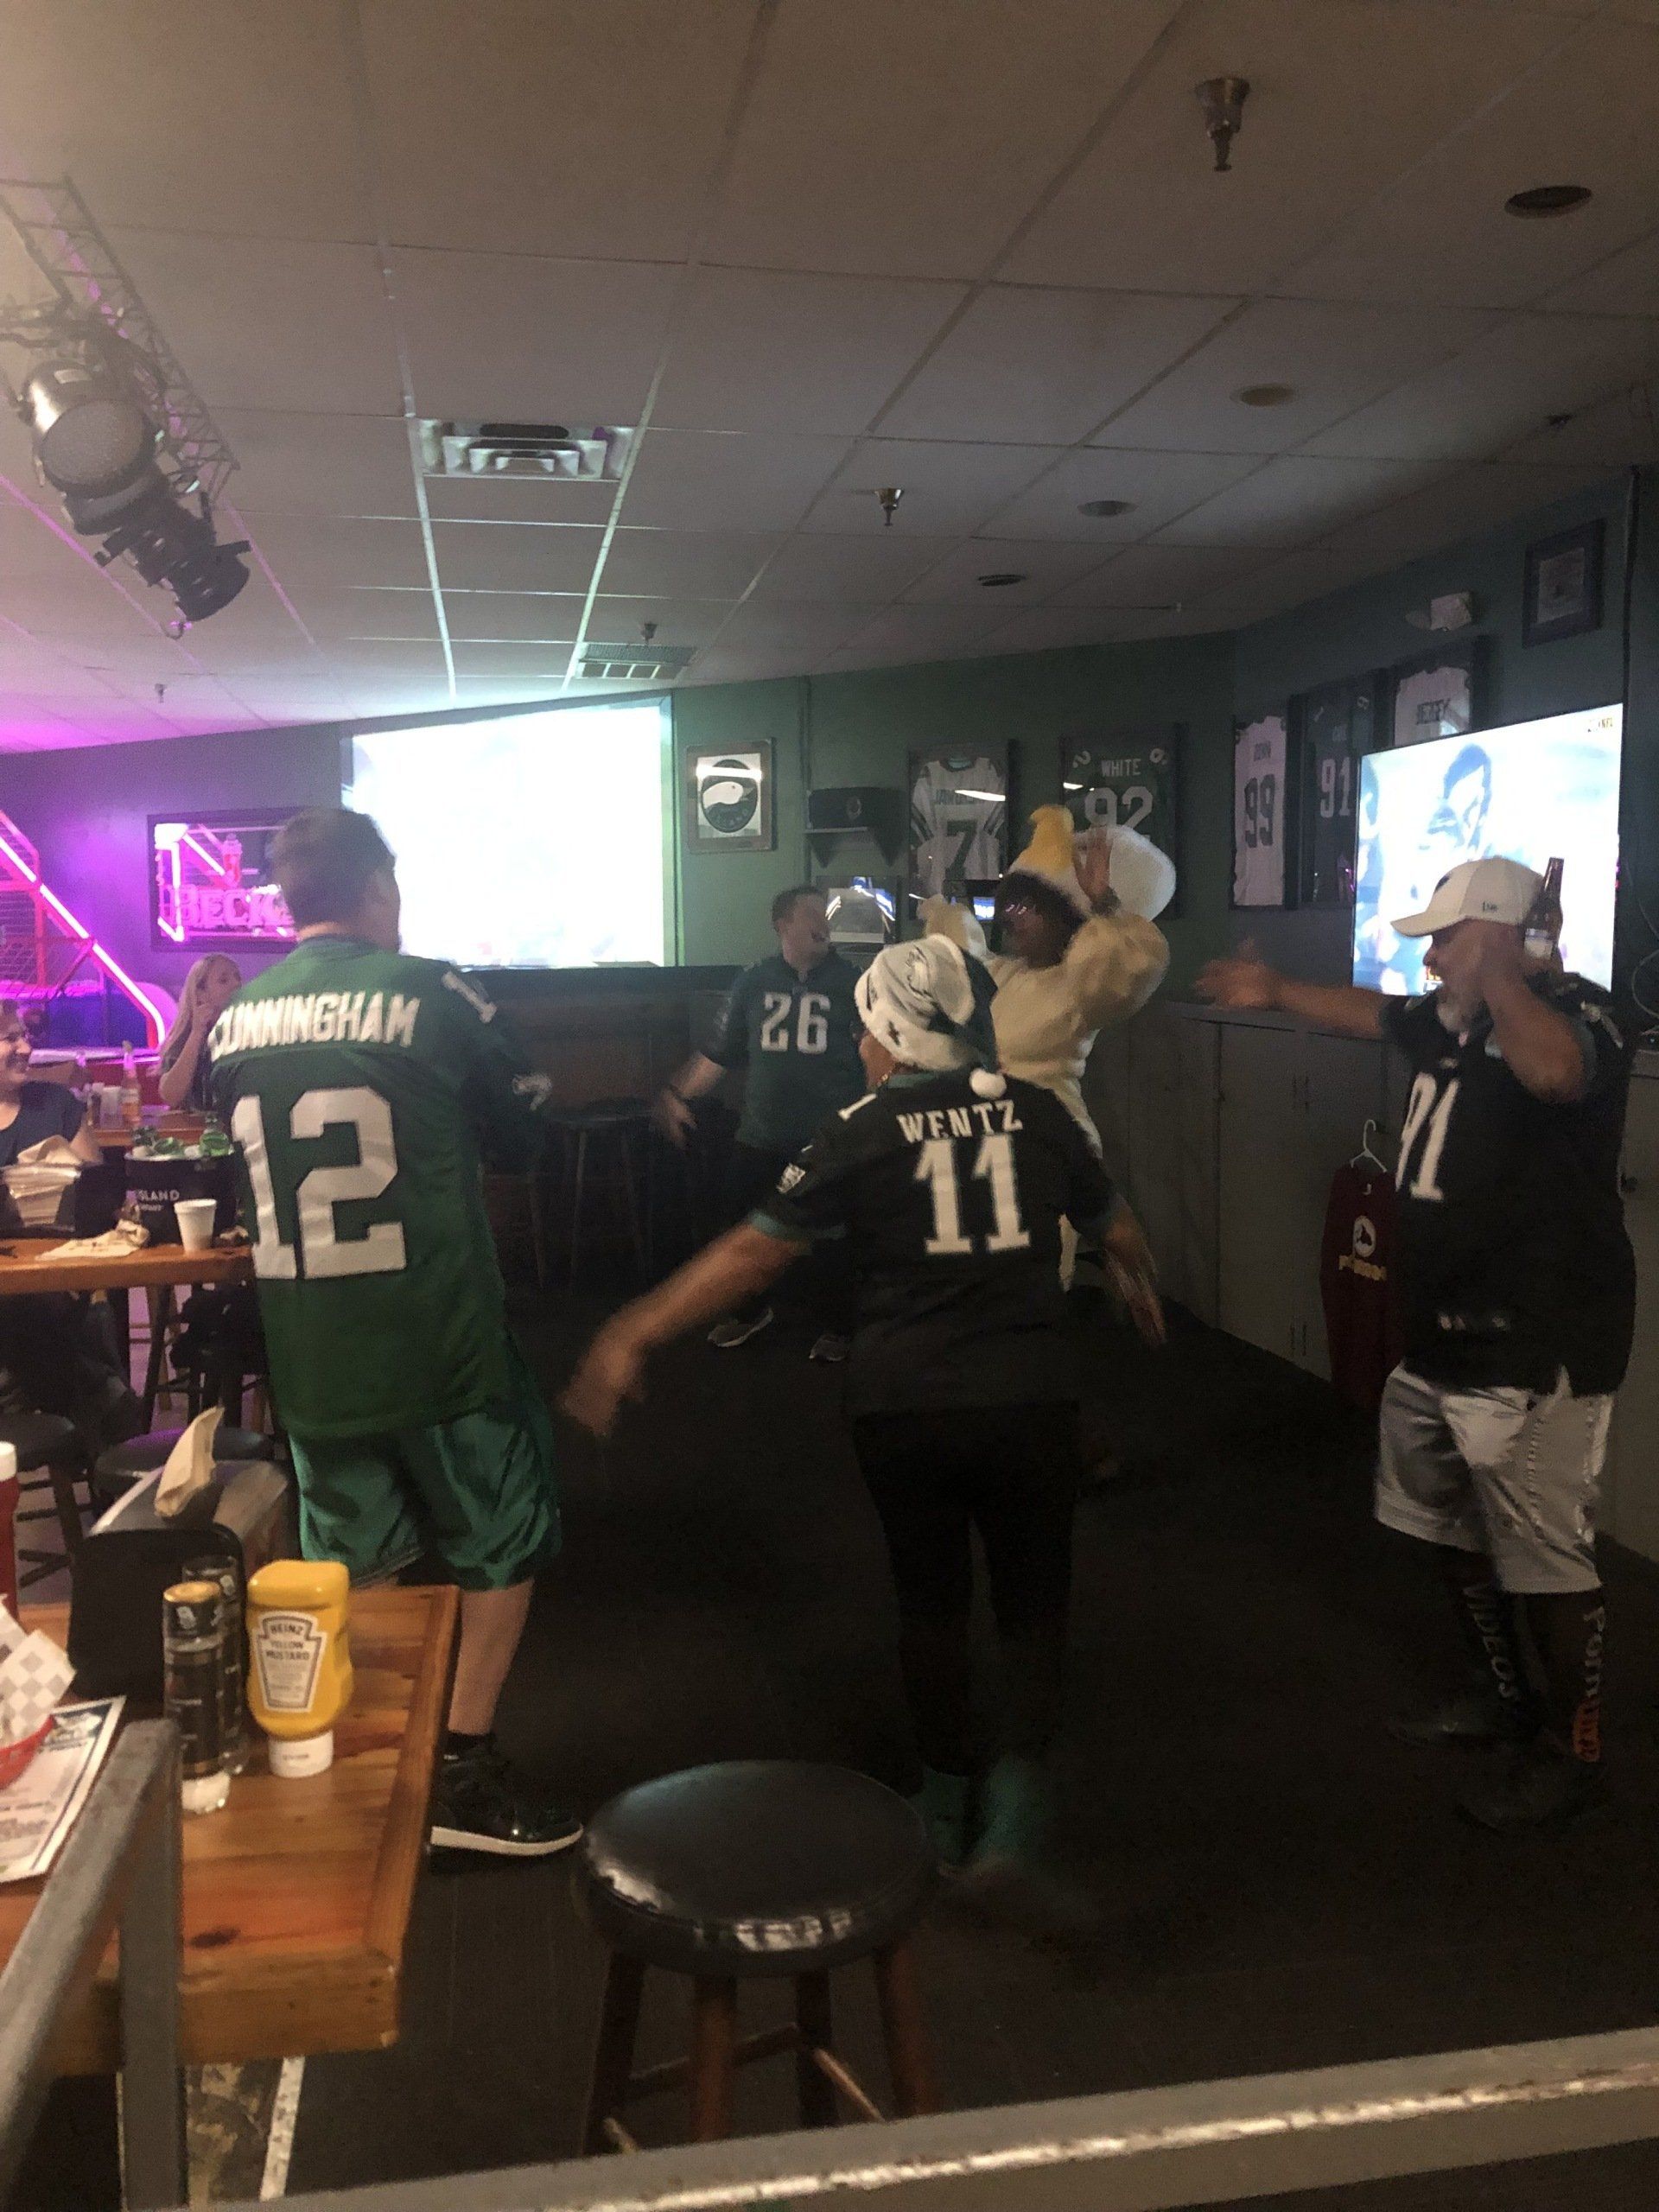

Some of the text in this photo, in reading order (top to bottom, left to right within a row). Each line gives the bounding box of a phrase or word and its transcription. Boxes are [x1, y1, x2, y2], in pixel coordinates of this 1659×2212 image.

[1101, 758, 1141, 778] WHITE
[1319, 756, 1351, 818] 91
[1244, 773, 1276, 849] 99
[207, 991, 420, 1058] CUNNINGHAM
[760, 992, 830, 1054] 26
[896, 1099, 1024, 1145] WENTZ
[133, 1189, 181, 1202] SLAND
[232, 1085, 407, 1280] 12
[913, 1133, 1031, 1255] 11
[265, 1649, 310, 1660] MUSTARD
[270, 1624, 304, 1636] HEINZ
